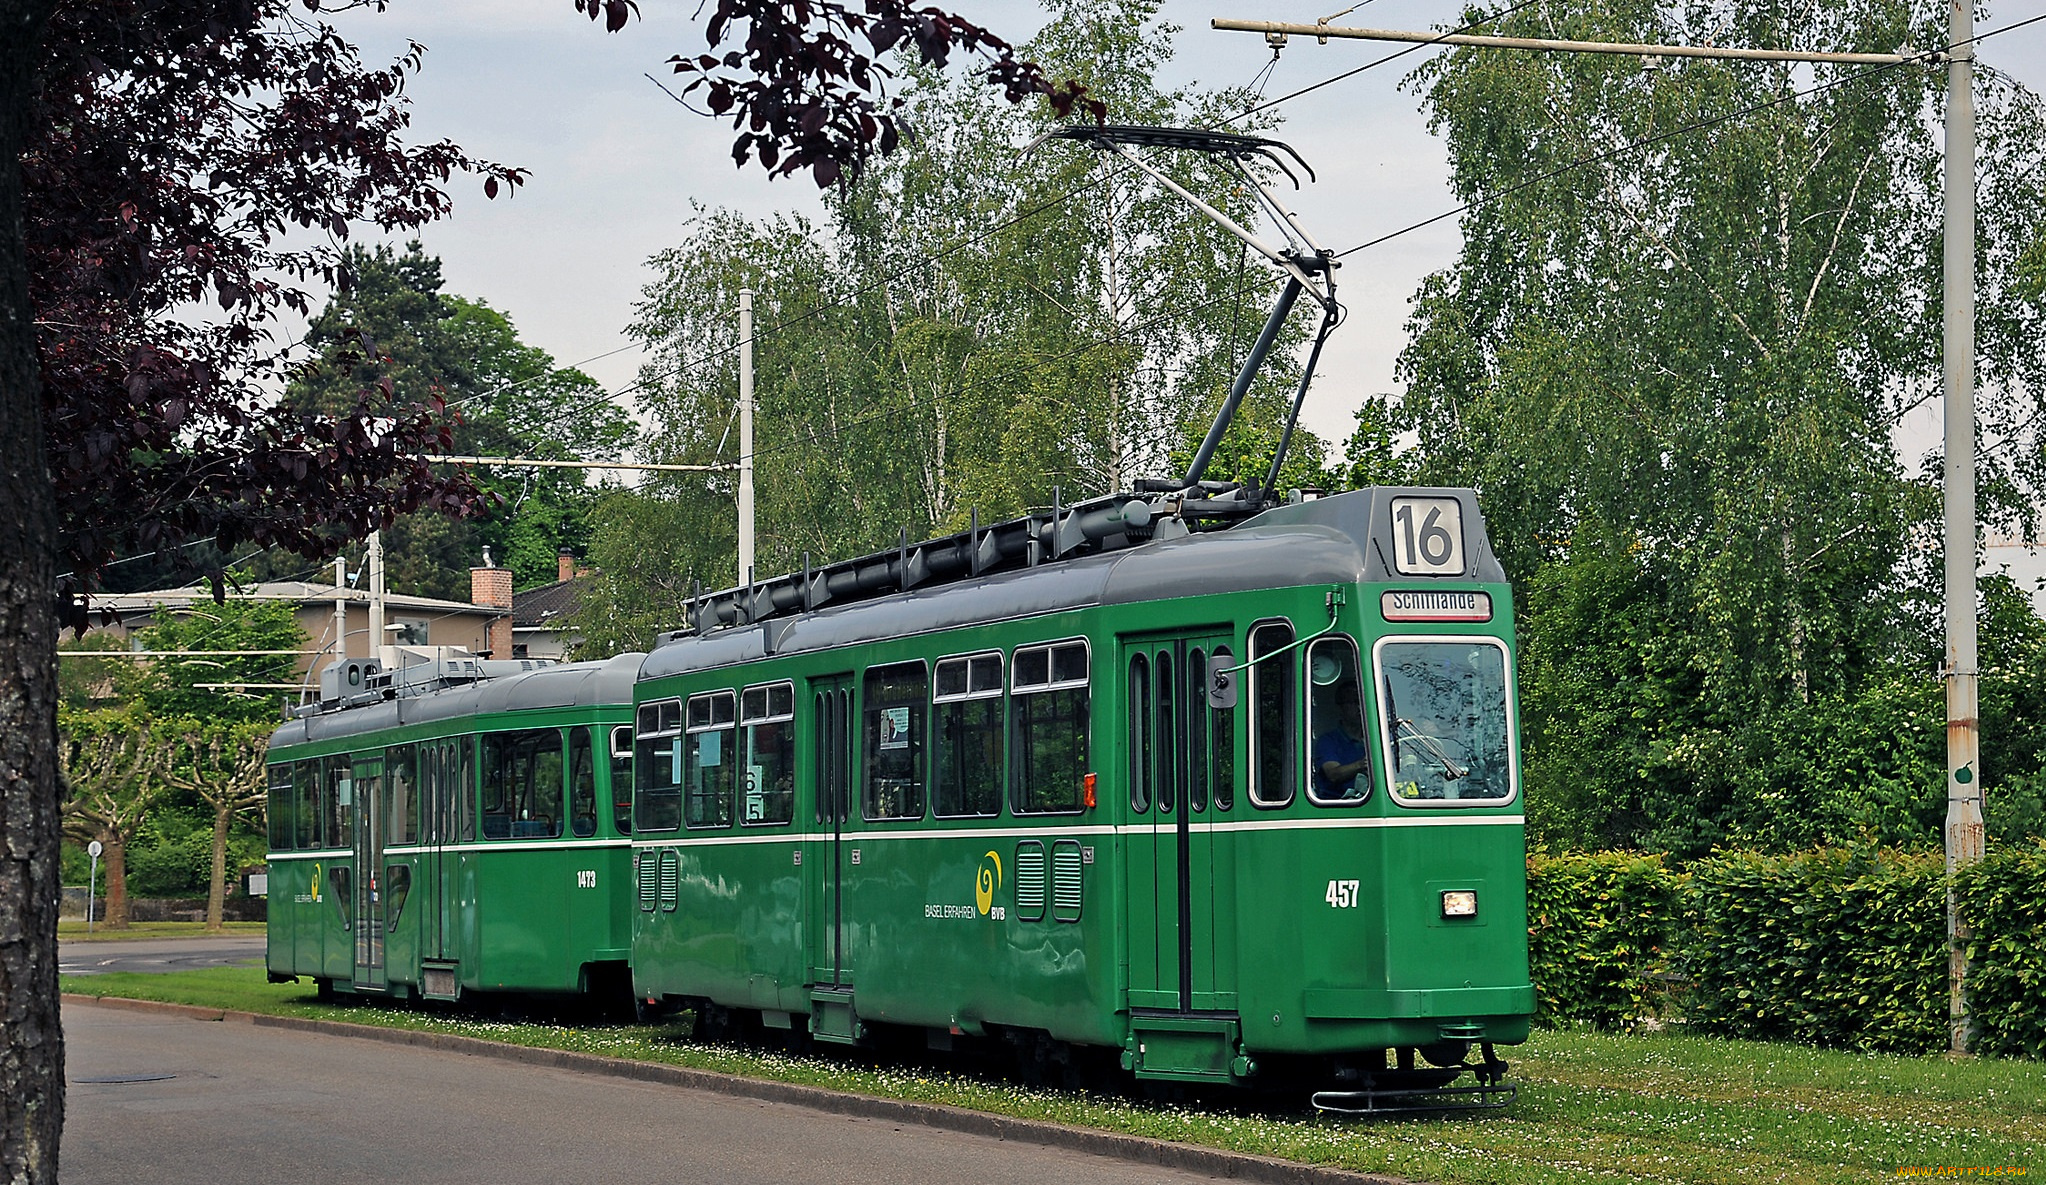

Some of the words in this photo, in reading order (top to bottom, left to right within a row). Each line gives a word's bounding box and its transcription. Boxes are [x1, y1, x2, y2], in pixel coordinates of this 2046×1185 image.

[1396, 505, 1453, 566] 16
[576, 870, 596, 888] 1473
[1325, 879, 1360, 908] 457
[924, 904, 944, 918] BASEL
[944, 904, 976, 919] ERFAHREN
[990, 906, 1006, 921] BVB
